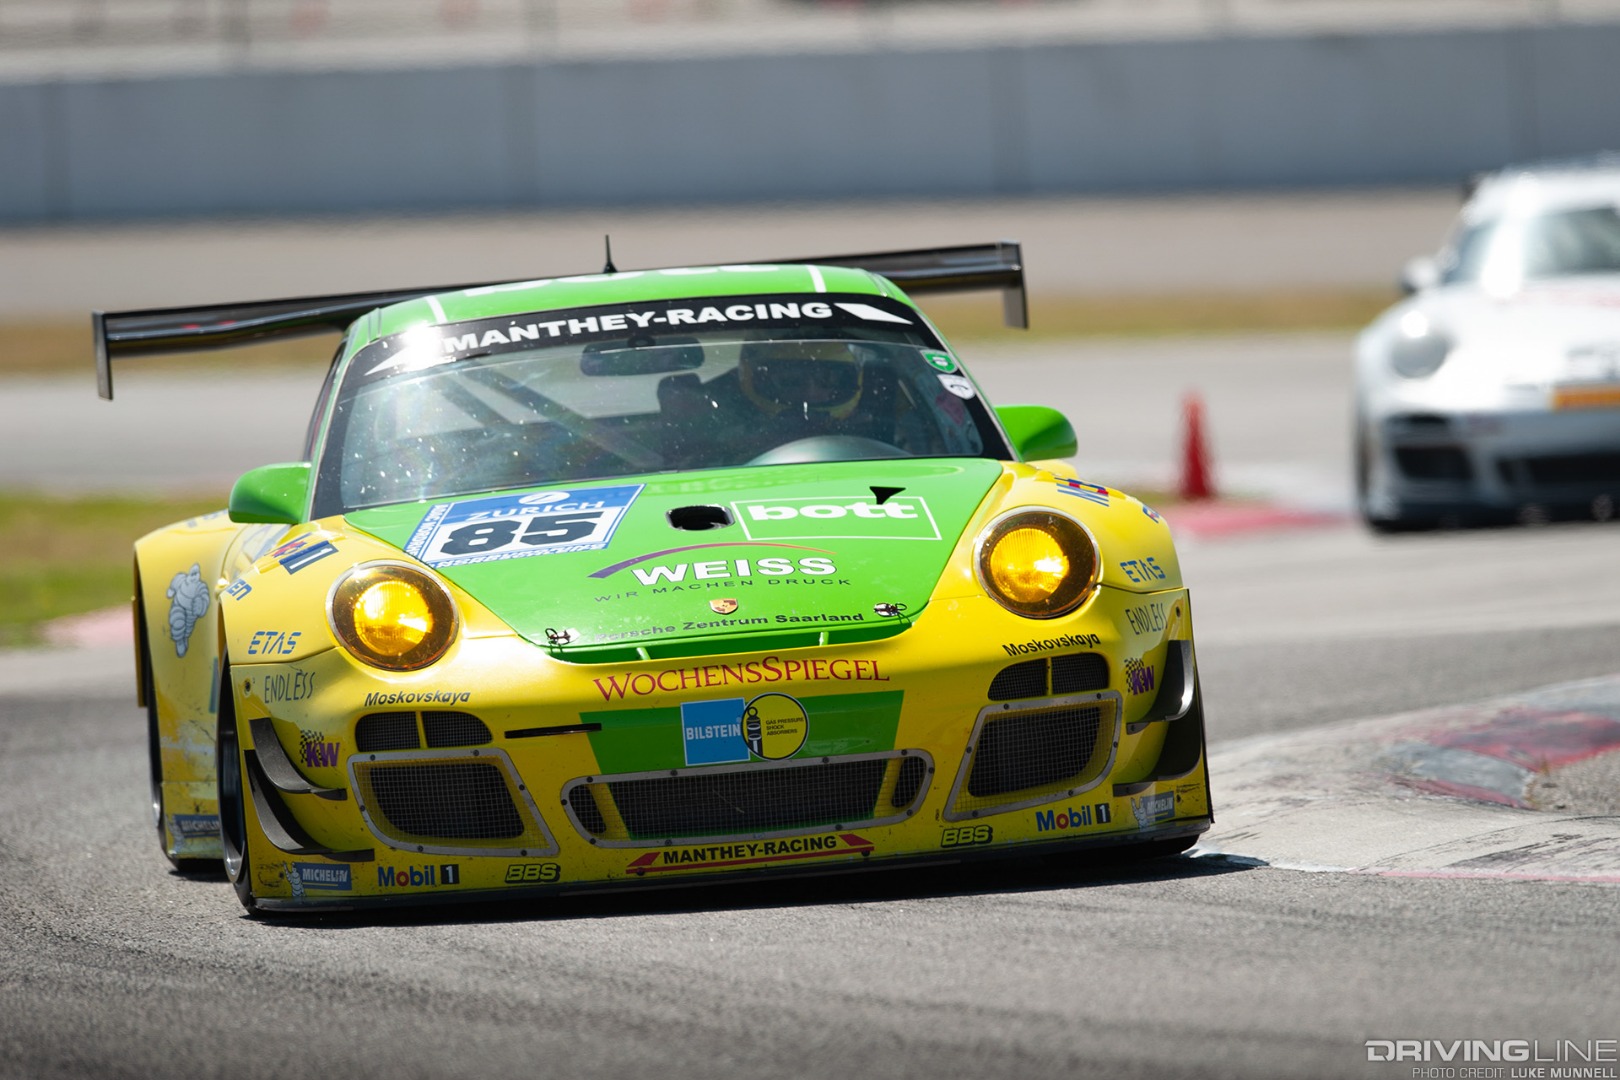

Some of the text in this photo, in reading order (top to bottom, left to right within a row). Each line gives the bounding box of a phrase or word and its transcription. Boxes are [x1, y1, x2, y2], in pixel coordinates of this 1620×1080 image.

[443, 302, 834, 354] MANTHEY-RACING
[464, 500, 605, 521] ZURICH
[748, 501, 919, 521] bott
[440, 511, 605, 556] 85
[631, 557, 838, 586] WEISS
[1119, 557, 1167, 583] ETAS
[594, 578, 852, 603] WIR MACHEN DRUCK
[594, 613, 865, 642] Porsche Zentrum Saarland
[1125, 603, 1168, 636] ENDLESS
[247, 631, 302, 655] ETAS
[1002, 633, 1102, 657] Moskovskaya
[264, 671, 316, 704] ENDLESS
[1132, 665, 1155, 696] KW
[364, 690, 471, 707] Moskovskaya
[686, 724, 741, 741] BILSTEIN
[306, 741, 340, 768] KW
[1036, 804, 1092, 832] Mobil
[941, 825, 993, 848] BBS
[663, 835, 837, 865] MANTHEY-RACING
[302, 868, 348, 882] MICHELIN
[378, 865, 435, 887] Mobil
[505, 862, 560, 883] BBS
